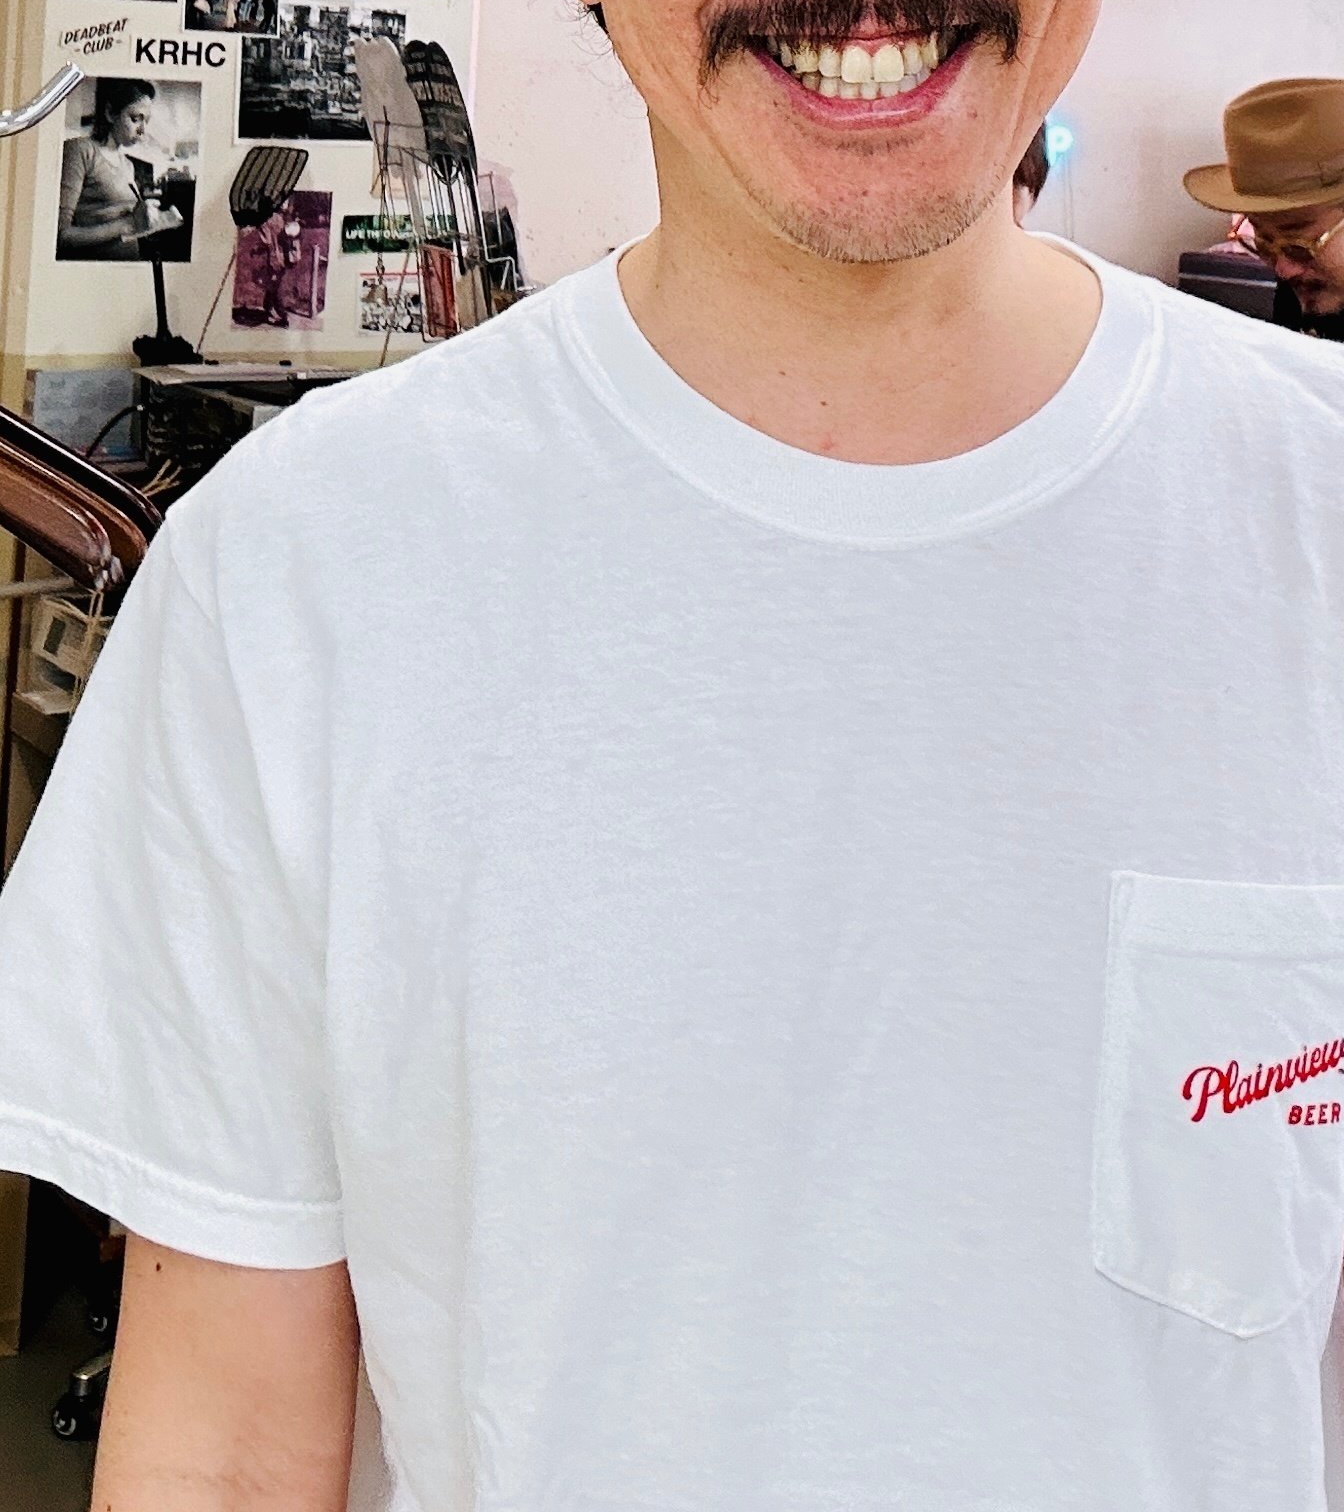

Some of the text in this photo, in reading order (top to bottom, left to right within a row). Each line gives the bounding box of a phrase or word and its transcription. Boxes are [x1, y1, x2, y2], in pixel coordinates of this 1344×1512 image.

[64, 18, 128, 45] DEADBEAT
[83, 36, 114, 55] CLUB
[135, 38, 226, 68] KRHC
[1288, 1102, 1342, 1126] BEER
